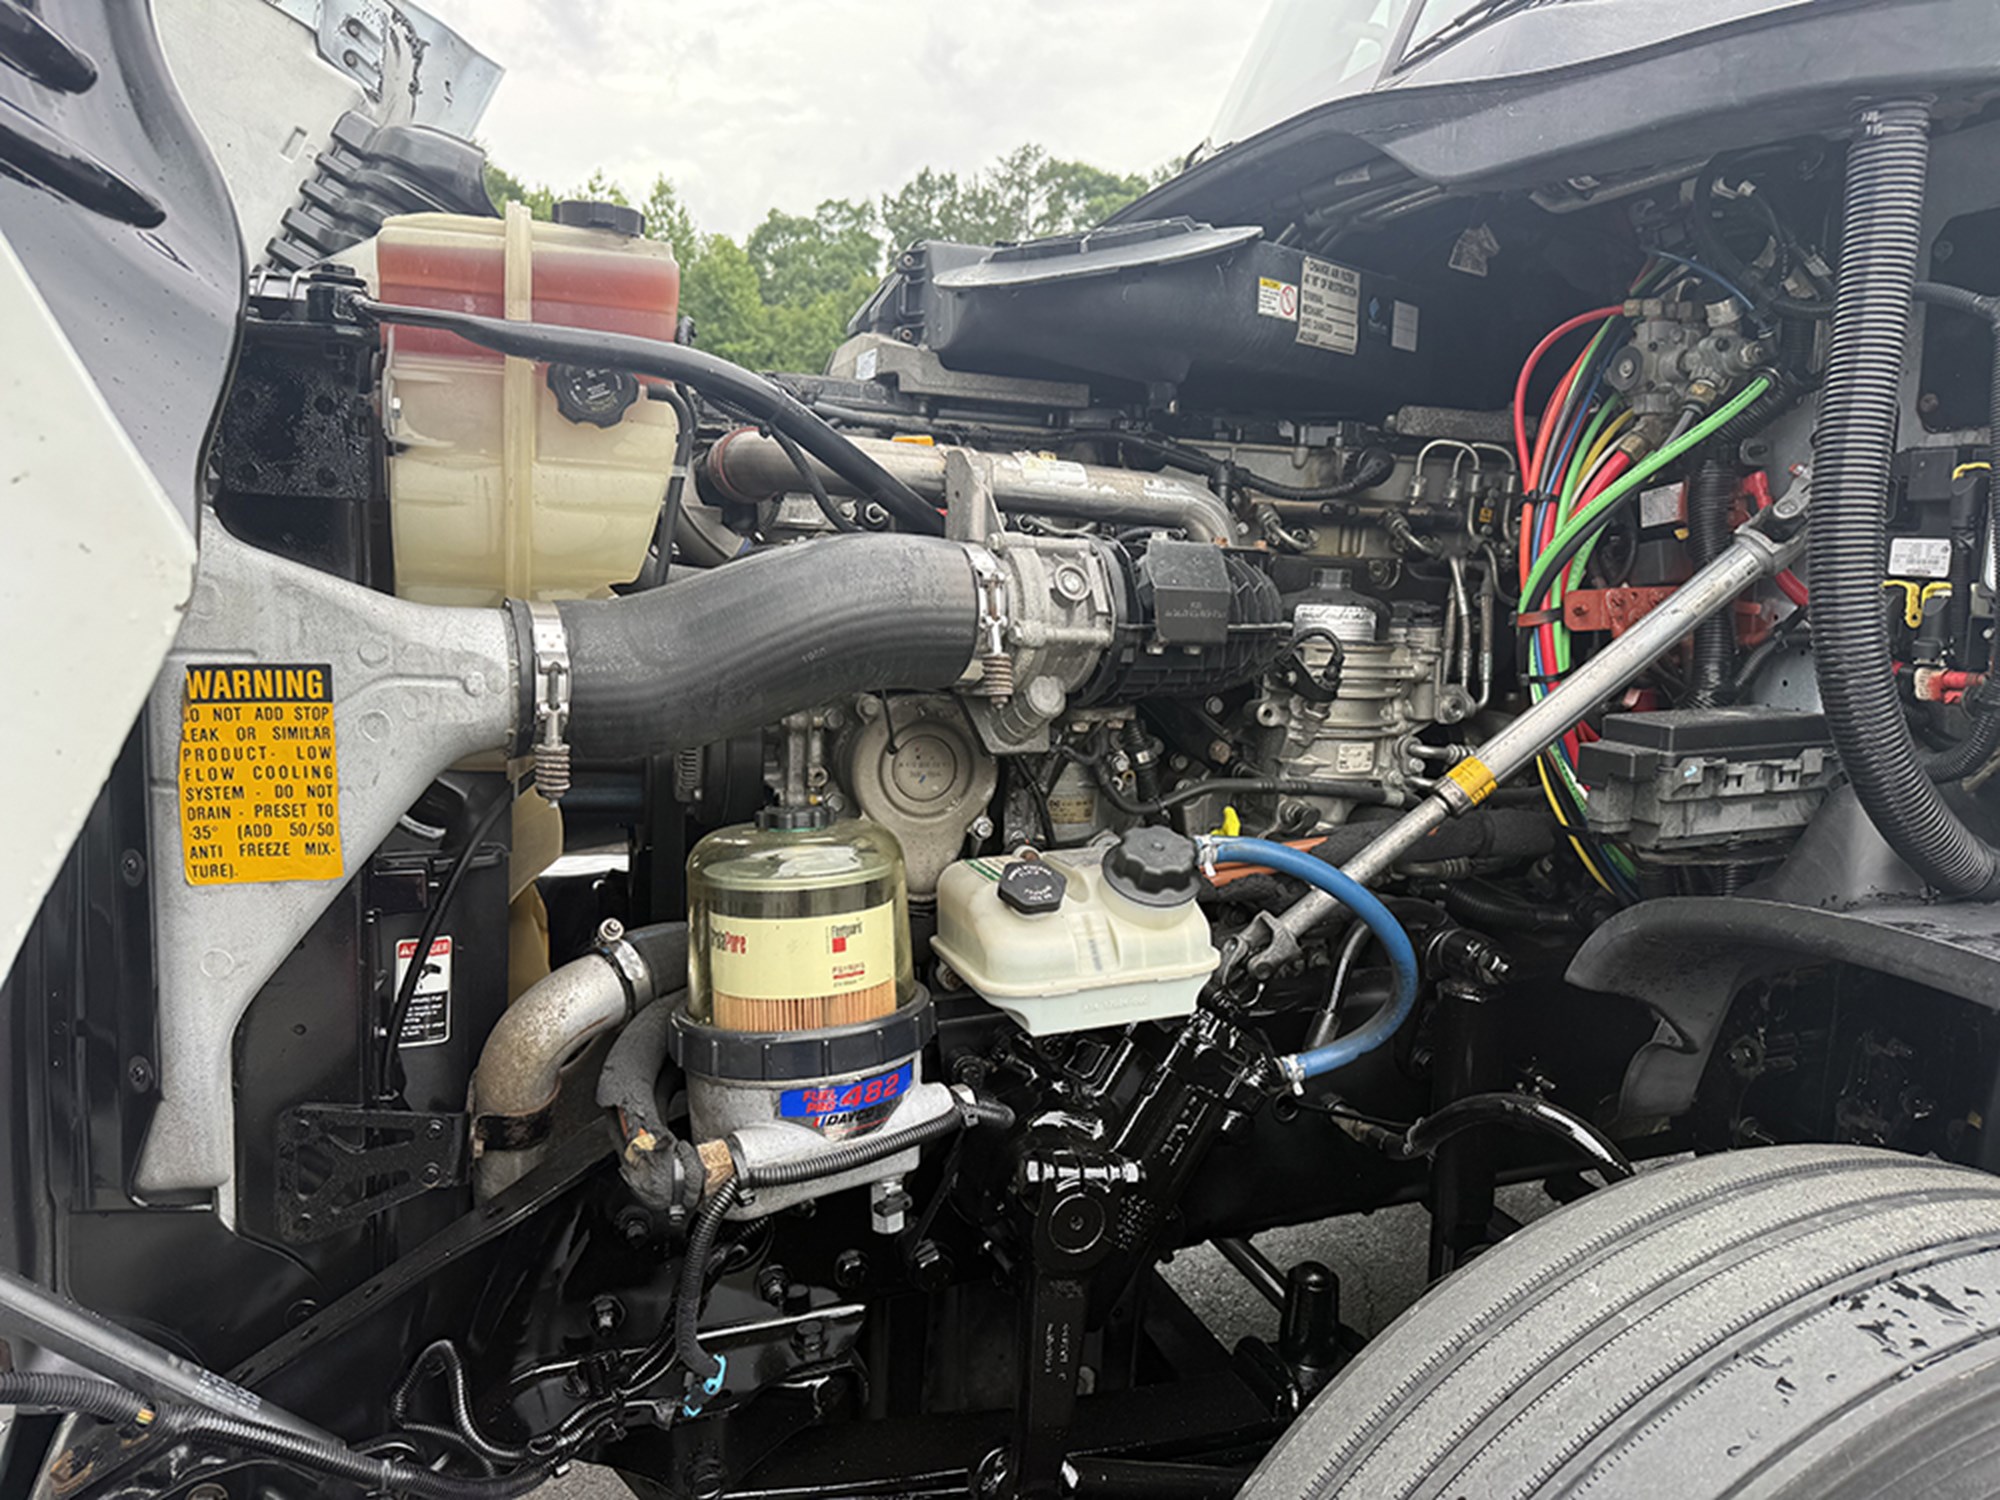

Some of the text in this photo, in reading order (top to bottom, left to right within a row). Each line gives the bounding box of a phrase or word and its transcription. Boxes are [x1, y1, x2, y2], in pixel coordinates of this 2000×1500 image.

[187, 670, 323, 699] WARNING
[213, 707, 241, 721] NOT
[255, 708, 283, 720] ADD
[294, 707, 329, 721] STOP
[182, 727, 331, 742] LEAK OR SIMILAR
[297, 746, 332, 759] LOW
[185, 766, 333, 781] FLOW COOLING
[186, 787, 244, 801] SYSTEM
[275, 785, 293, 798] DO
[307, 785, 333, 798] NOT
[188, 806, 231, 820] DRAIN
[255, 804, 306, 818] PRESET
[317, 804, 333, 817] TO
[238, 824, 272, 840] (ADD
[290, 823, 334, 836] 50/50
[190, 845, 223, 859] ANTI
[240, 843, 290, 856] FREEZE
[802, 1088, 837, 1102] FUEL
[839, 1073, 899, 1107] 482
[806, 1100, 836, 1114] PRO
